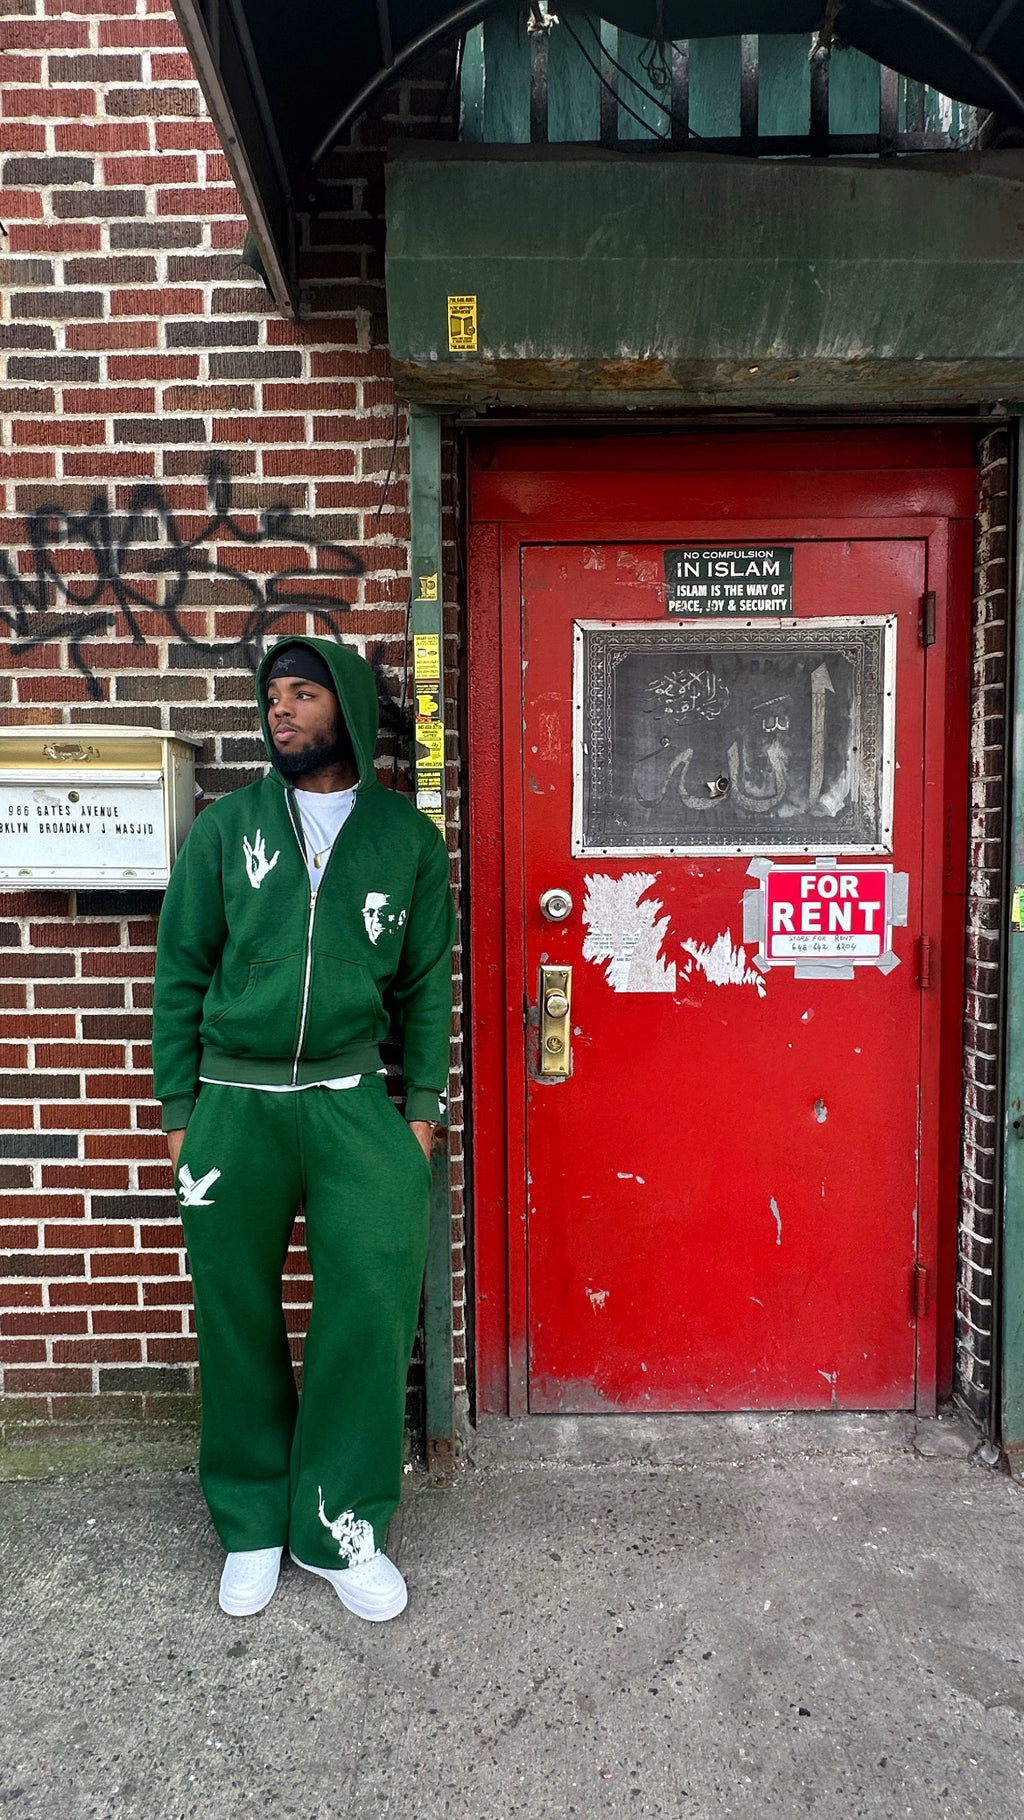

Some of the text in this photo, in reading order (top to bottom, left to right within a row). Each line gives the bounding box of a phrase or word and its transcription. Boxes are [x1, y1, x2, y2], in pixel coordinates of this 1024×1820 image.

[684, 551, 774, 560] NO COMPULSION
[677, 561, 780, 578] IN ISLAM
[677, 583, 785, 597] ISLAM IS THE WAY OF
[669, 599, 787, 614] PEACE, JOY & SECURITY
[8, 805, 119, 817] 986 GATES AVENUE
[101, 823, 106, 834] J
[115, 823, 153, 834] MASJID
[801, 875, 859, 899] FOR
[772, 901, 881, 932] RENT
